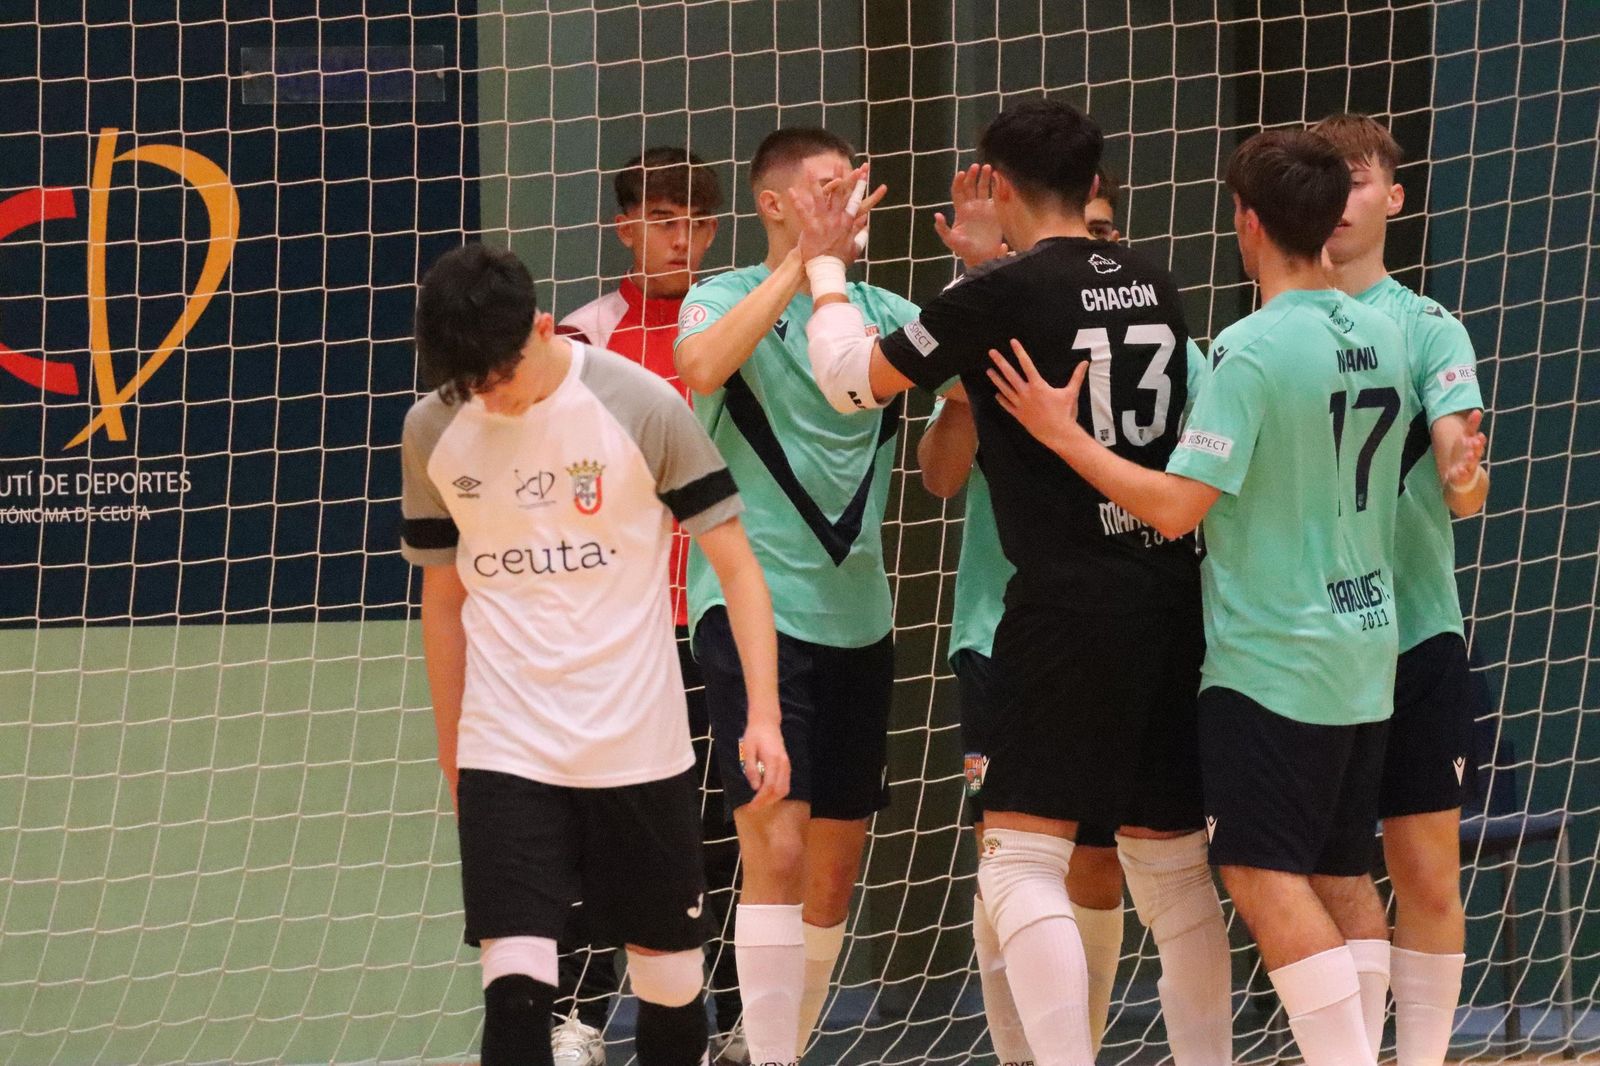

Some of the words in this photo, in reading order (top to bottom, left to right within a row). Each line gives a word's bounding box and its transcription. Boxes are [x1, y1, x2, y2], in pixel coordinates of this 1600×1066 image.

[1080, 280, 1159, 312] CHACÓN
[1336, 345, 1379, 374] NANU
[1071, 323, 1177, 448] 13
[1329, 386, 1402, 517] 17
[39, 473, 70, 496] DE
[75, 471, 192, 495] DEPORTES
[74, 507, 97, 523] DE
[100, 505, 151, 522] CEUTA
[1359, 607, 1390, 632] 2011
